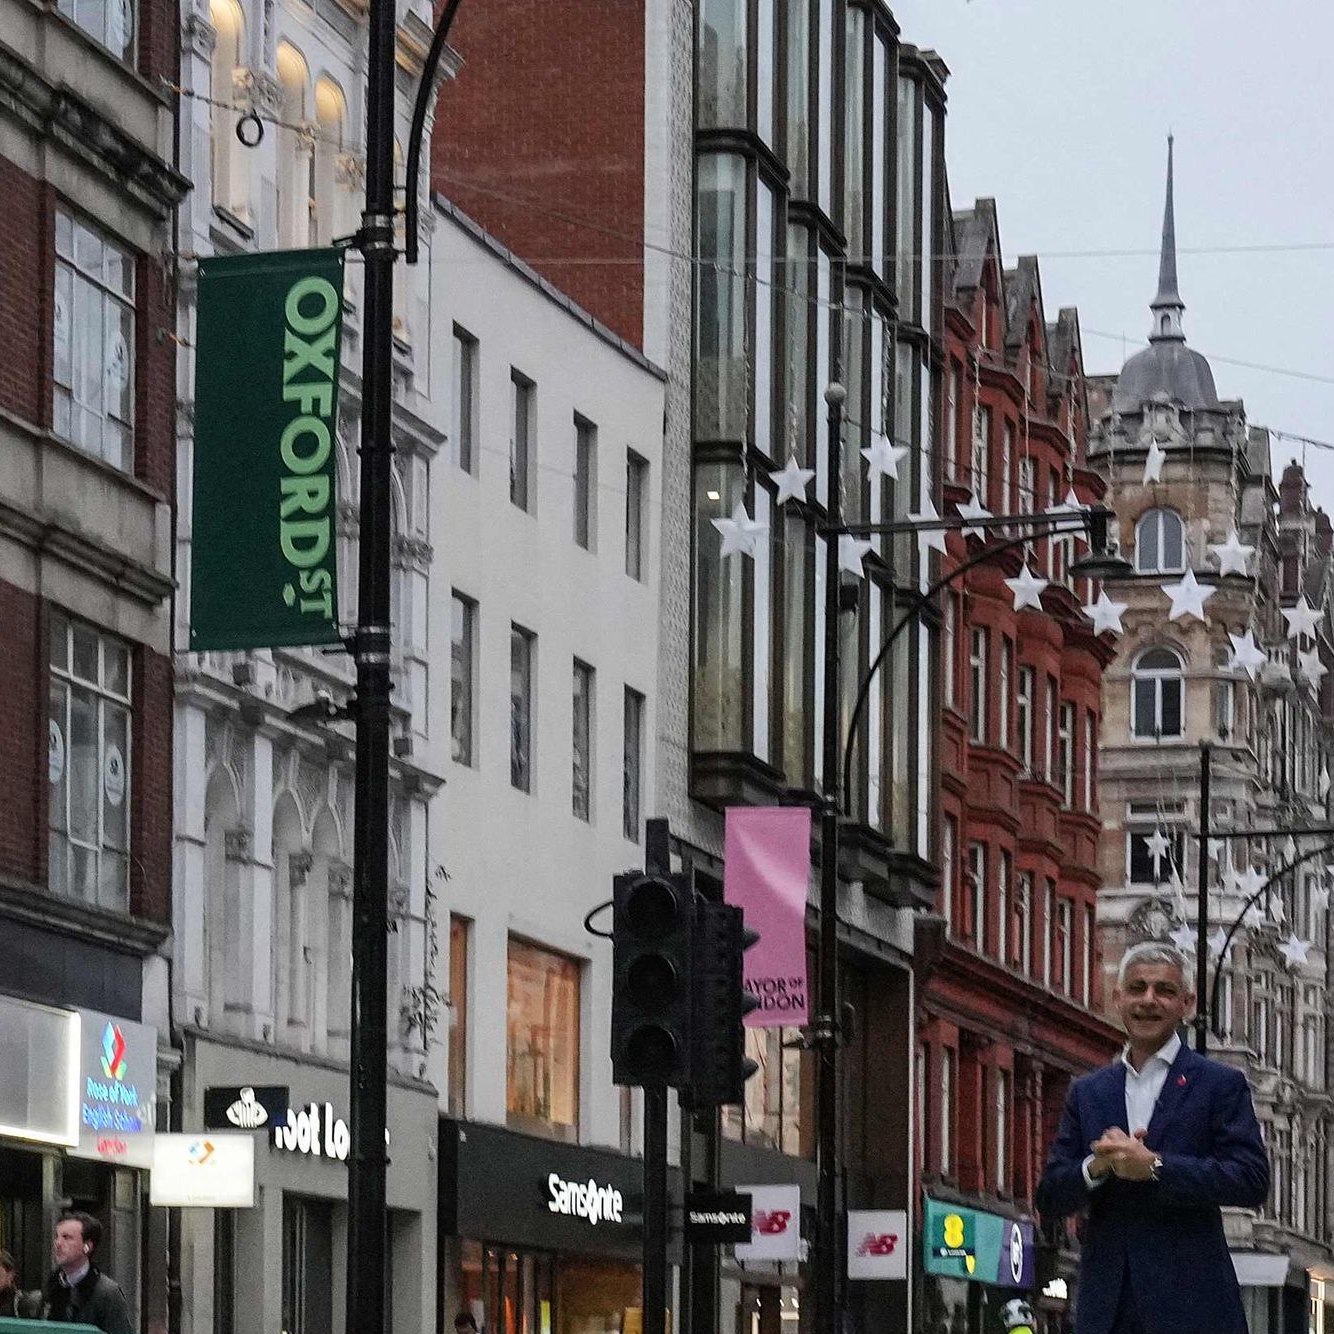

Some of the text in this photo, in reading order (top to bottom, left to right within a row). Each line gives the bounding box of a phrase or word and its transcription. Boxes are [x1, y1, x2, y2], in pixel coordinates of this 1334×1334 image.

[279, 276, 339, 568] OXFORD
[745, 977, 787, 996] AYOR
[548, 1172, 623, 1225] Samsonite
[689, 1209, 746, 1226] Samsonite
